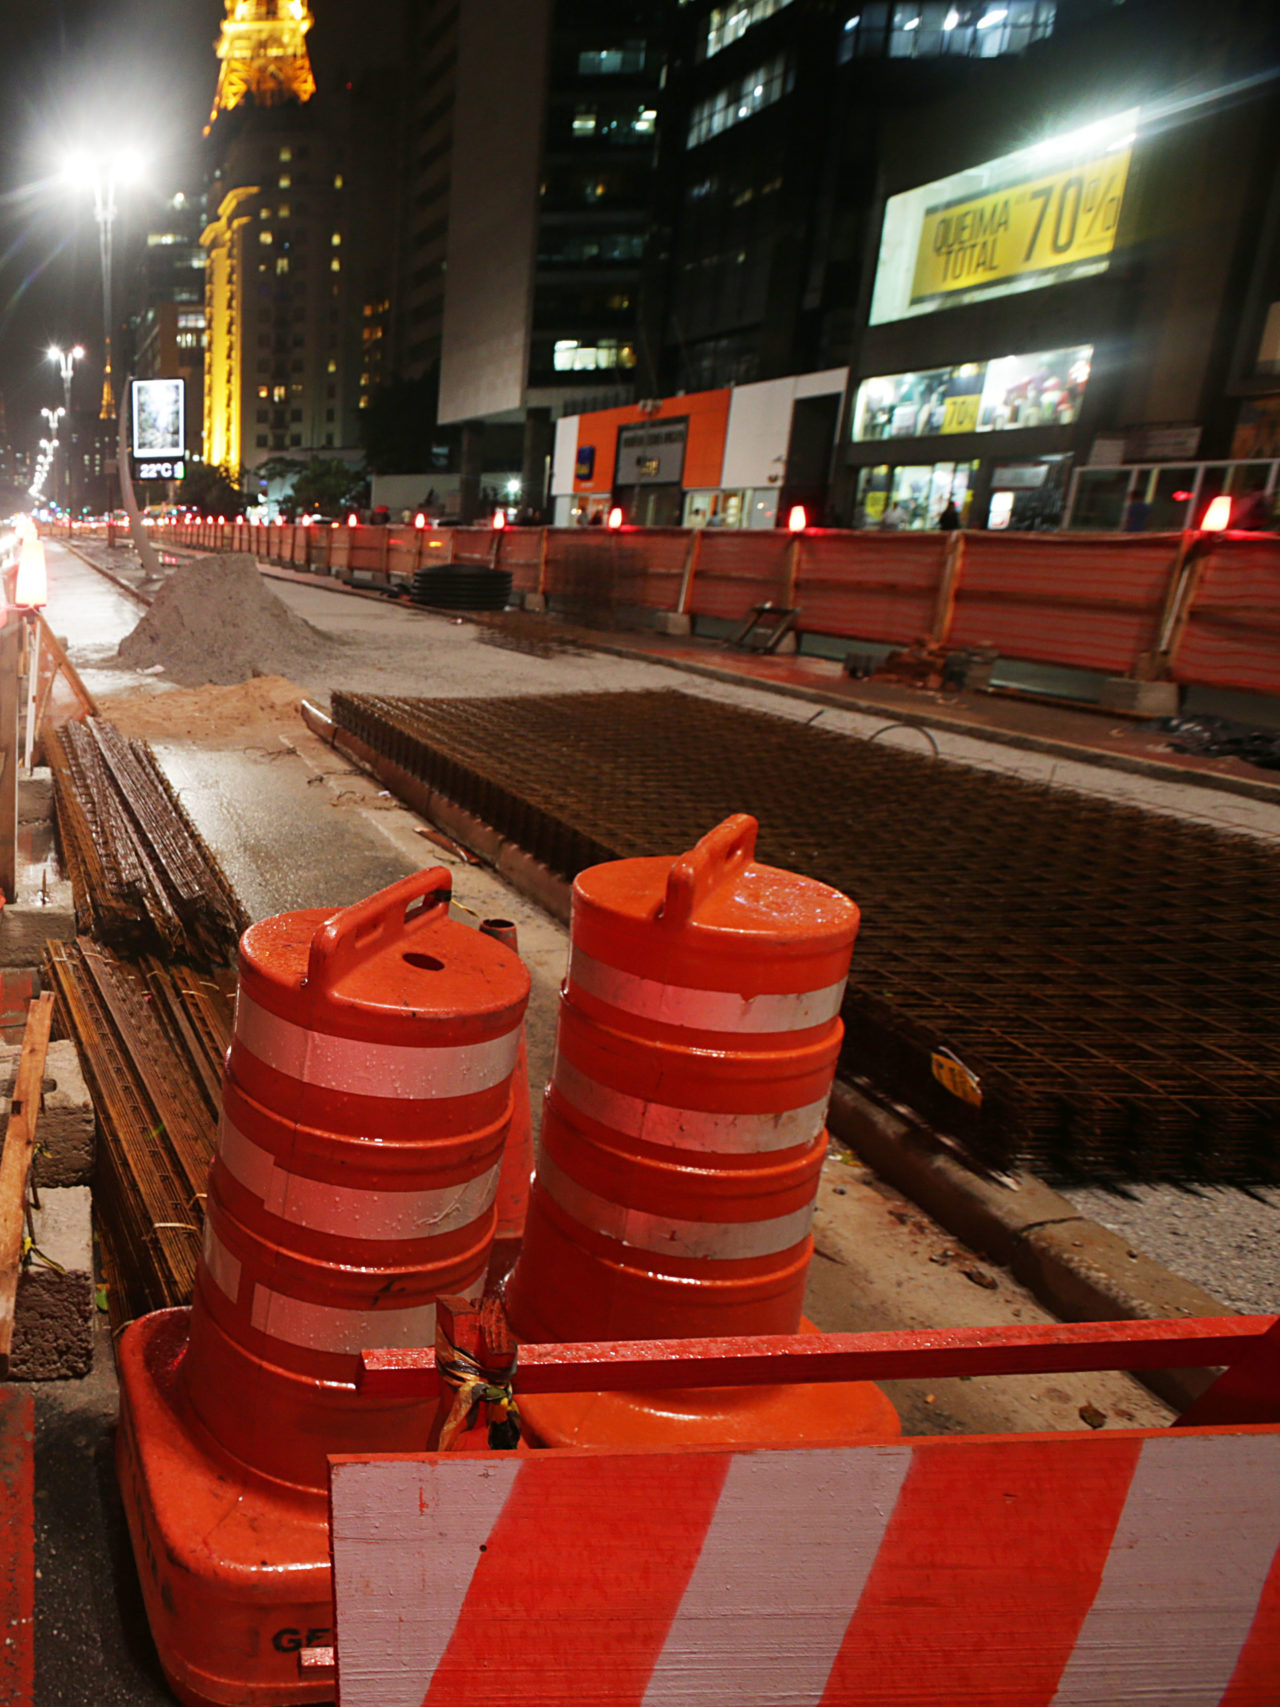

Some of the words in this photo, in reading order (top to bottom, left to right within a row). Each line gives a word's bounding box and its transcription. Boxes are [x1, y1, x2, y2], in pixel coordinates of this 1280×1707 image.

[933, 199, 1009, 256] QUEIMA
[1023, 174, 1121, 262] 70%
[942, 237, 1000, 283] TOTAL
